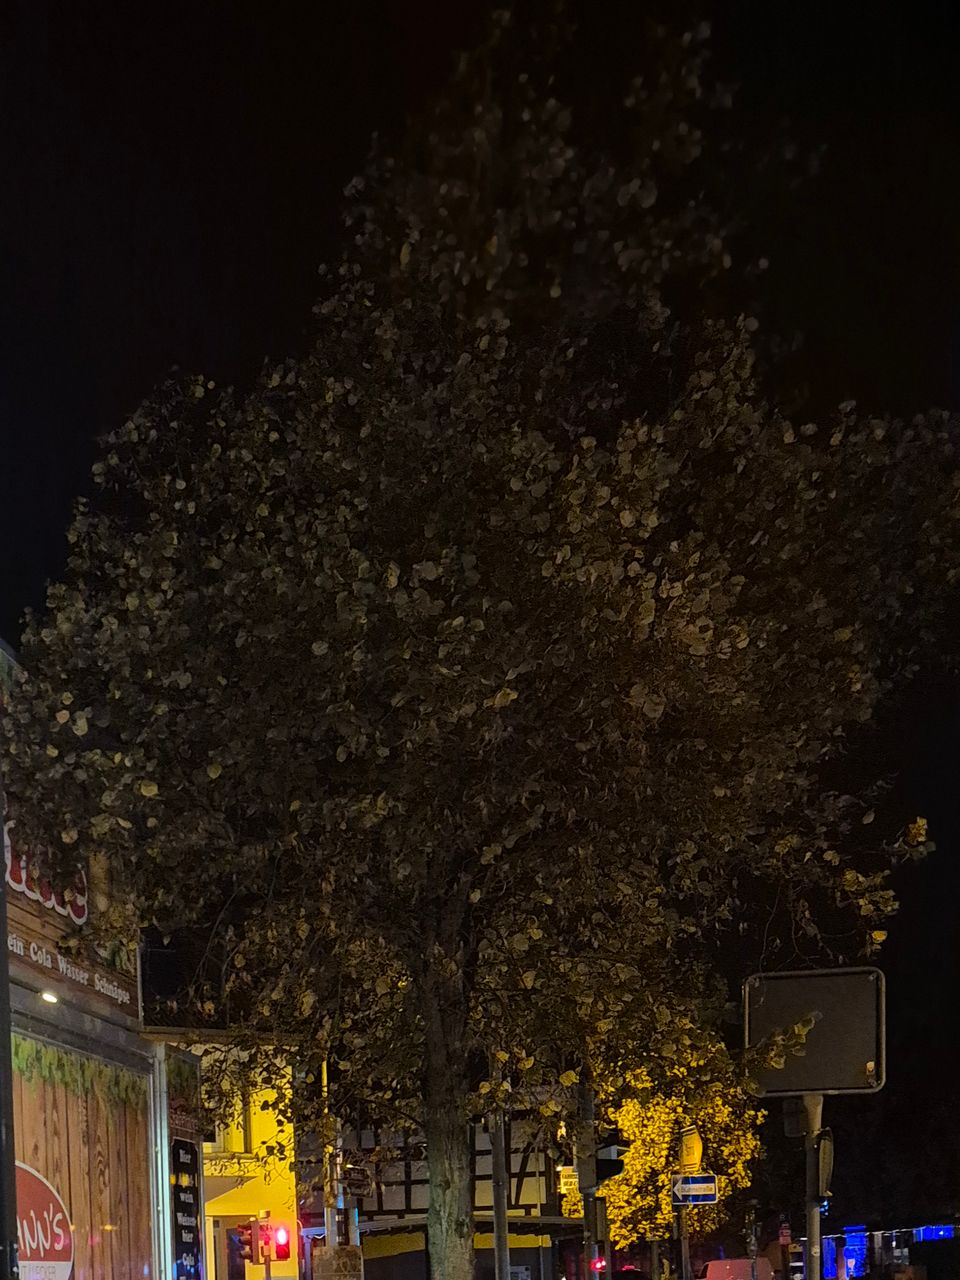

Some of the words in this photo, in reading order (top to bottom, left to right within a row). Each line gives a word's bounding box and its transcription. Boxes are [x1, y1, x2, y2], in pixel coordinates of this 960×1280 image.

[7, 933, 24, 957] ein
[29, 942, 52, 969] Cola
[56, 953, 90, 987] Wasser
